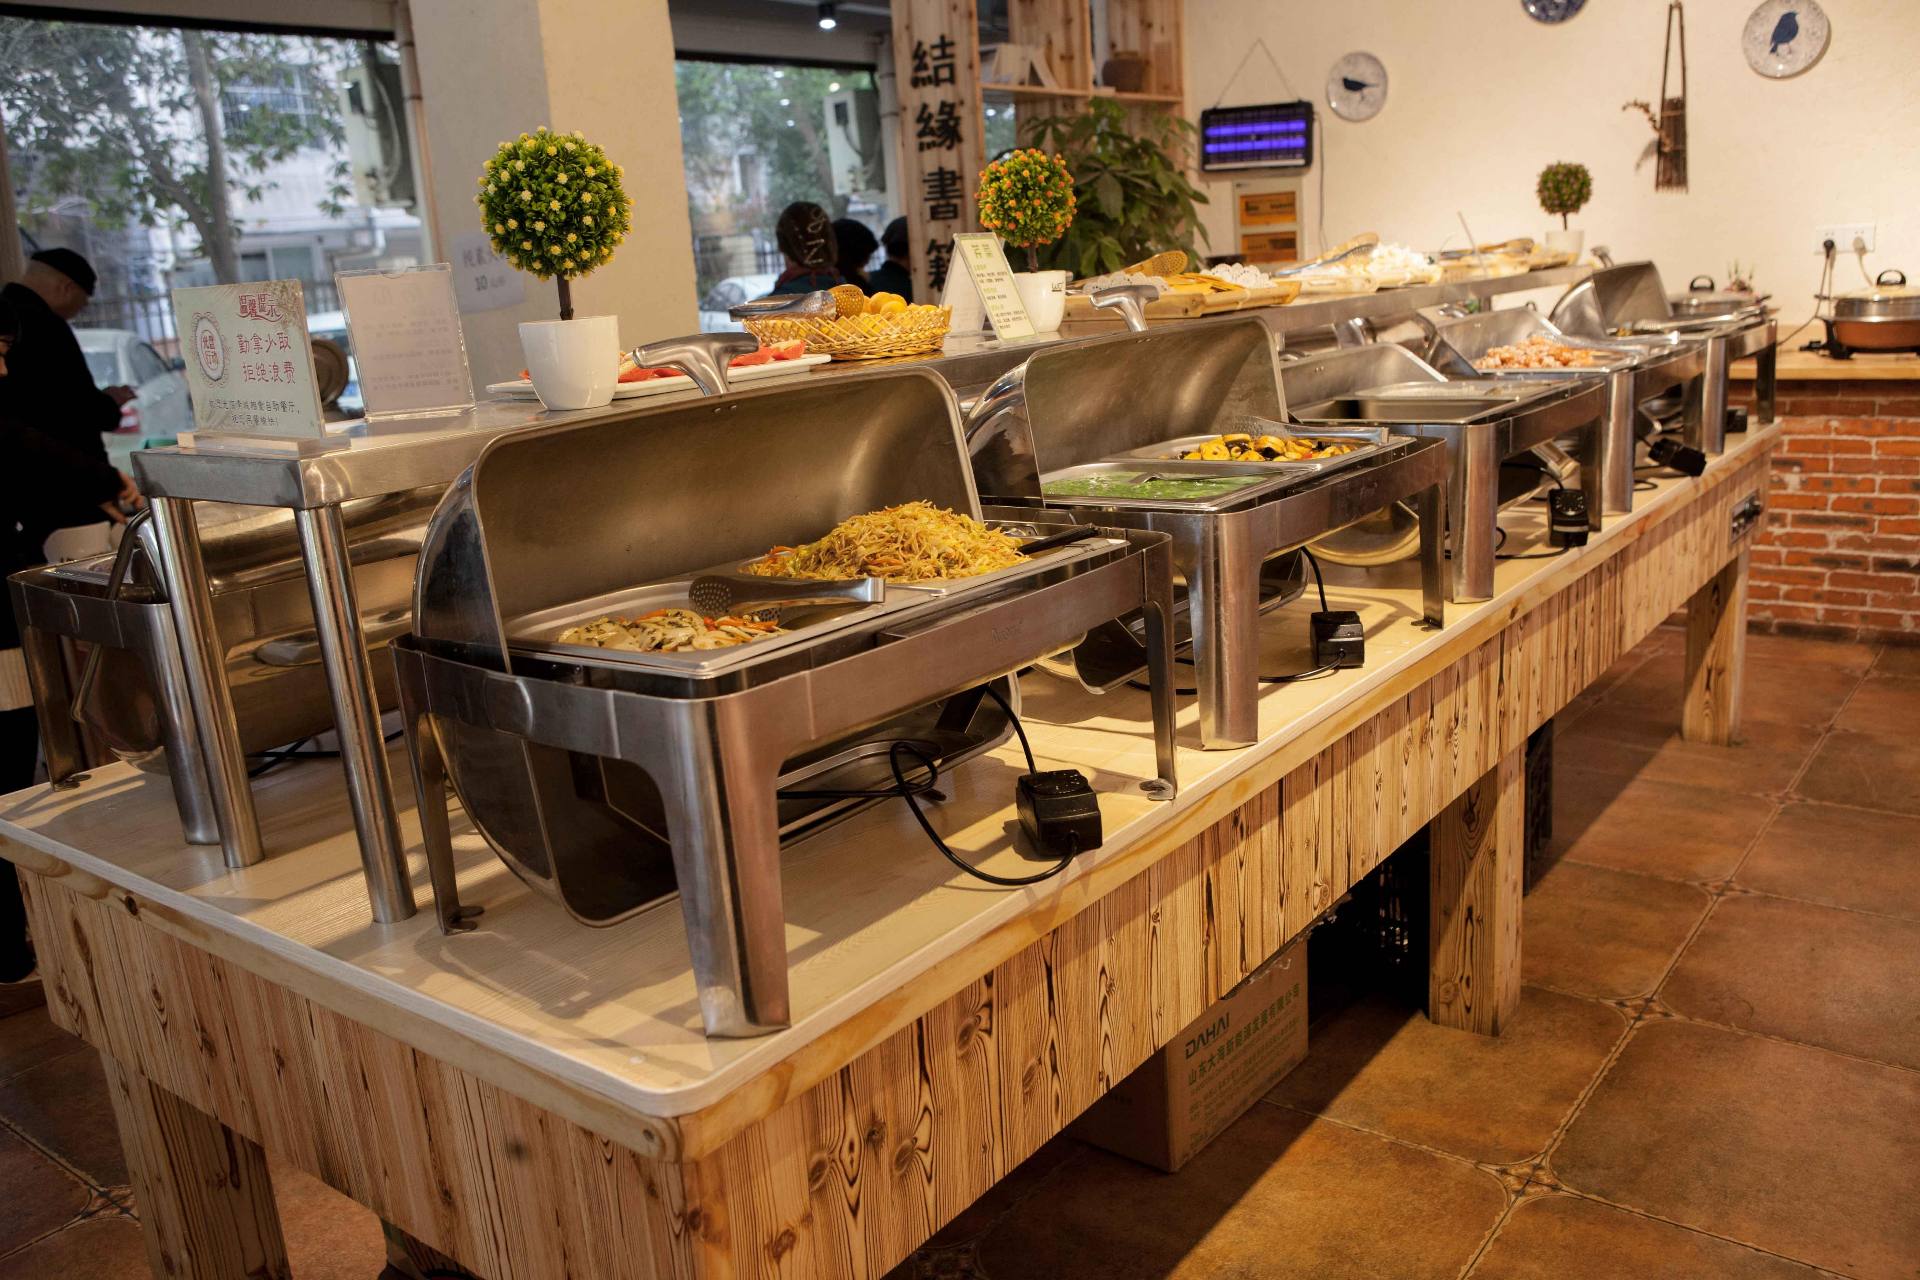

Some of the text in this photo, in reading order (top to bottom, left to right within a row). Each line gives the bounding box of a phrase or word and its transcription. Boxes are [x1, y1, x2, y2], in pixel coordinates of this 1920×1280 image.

[236, 332, 291, 354] 勤拿少取
[243, 361, 295, 384] 拒绝浪费
[1185, 1012, 1230, 1060] DAHAI
